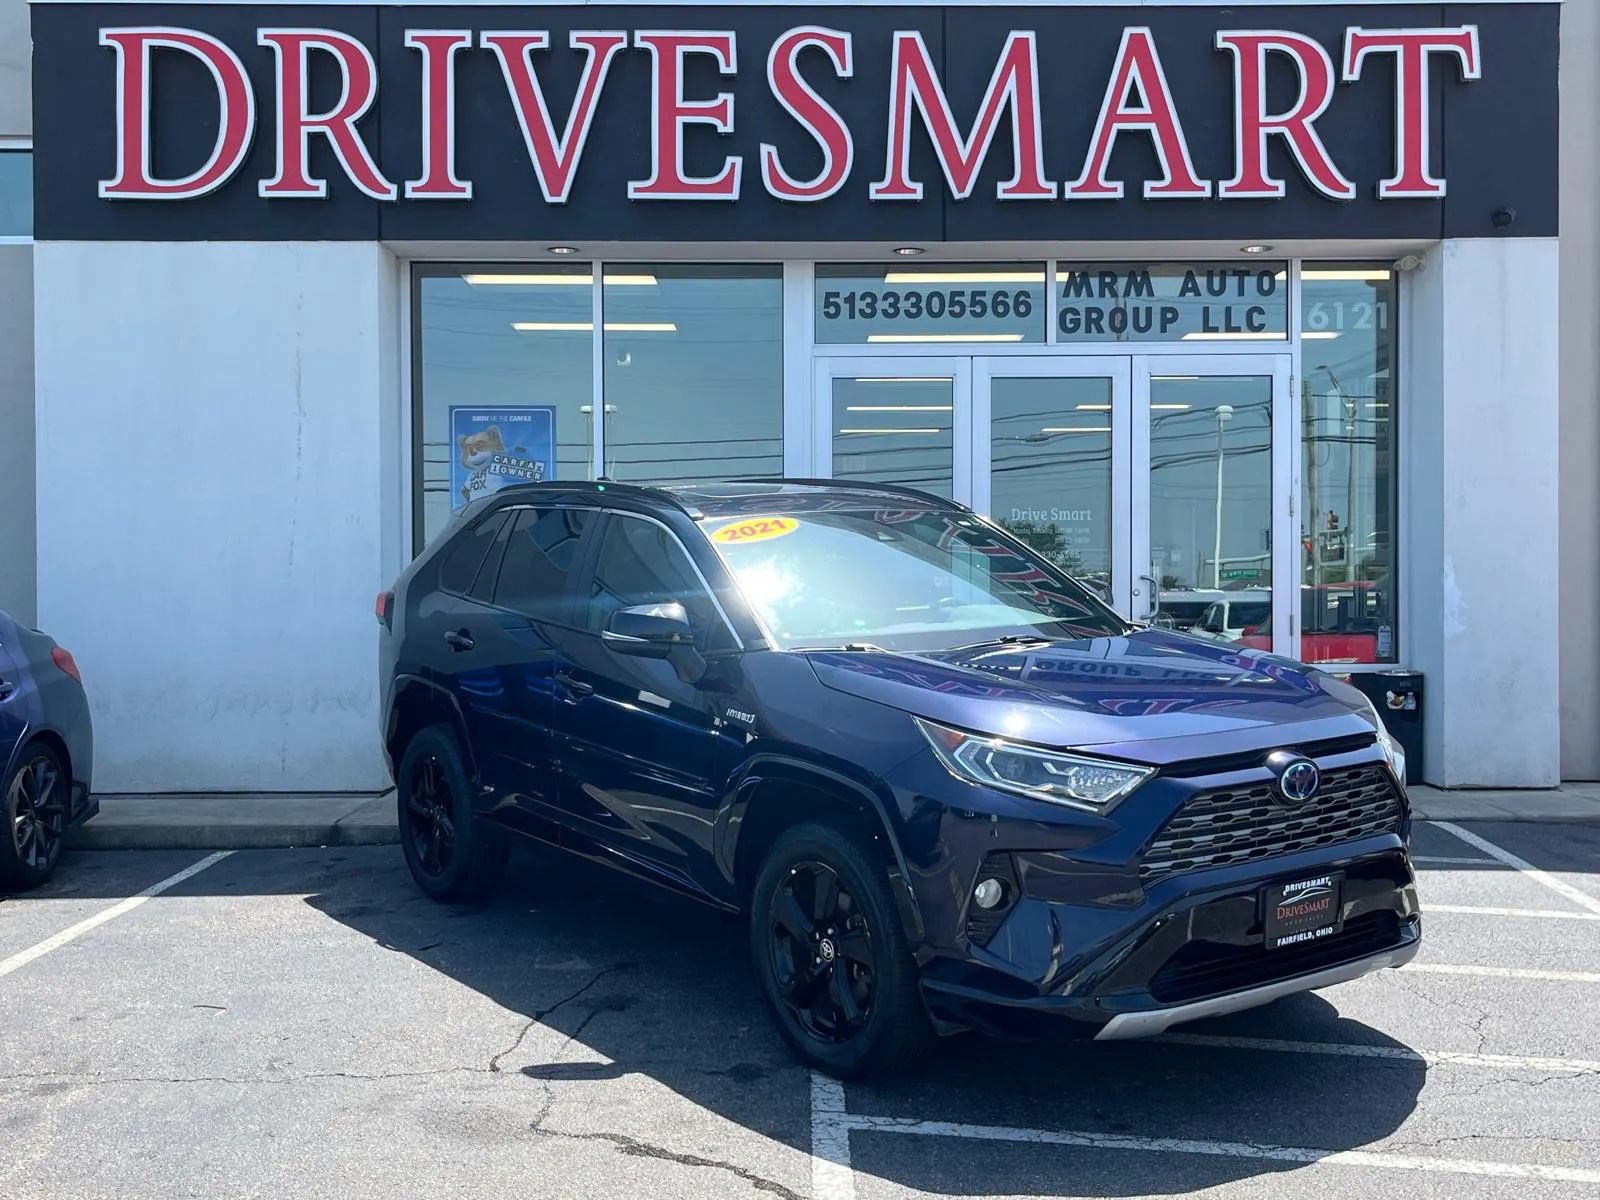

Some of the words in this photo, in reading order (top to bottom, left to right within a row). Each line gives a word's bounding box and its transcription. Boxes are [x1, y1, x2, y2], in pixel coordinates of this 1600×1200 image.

[98, 25, 1482, 205] DRIVESMART
[1062, 269, 1155, 298] MRM
[1179, 269, 1276, 298] AUTO
[823, 289, 1032, 320] 5133305566
[1307, 302, 1388, 331] 6121
[1058, 305, 1180, 335] GROUP
[1202, 305, 1267, 334] LLC
[494, 455, 544, 472] CARFAX
[1011, 507, 1048, 521] Drive
[1050, 507, 1092, 521] Smart
[723, 519, 787, 541] 2021
[1285, 876, 1330, 892] DRIVESMART
[1277, 931, 1315, 947] FAIRFIELD,
[1316, 926, 1333, 937] OHIO
